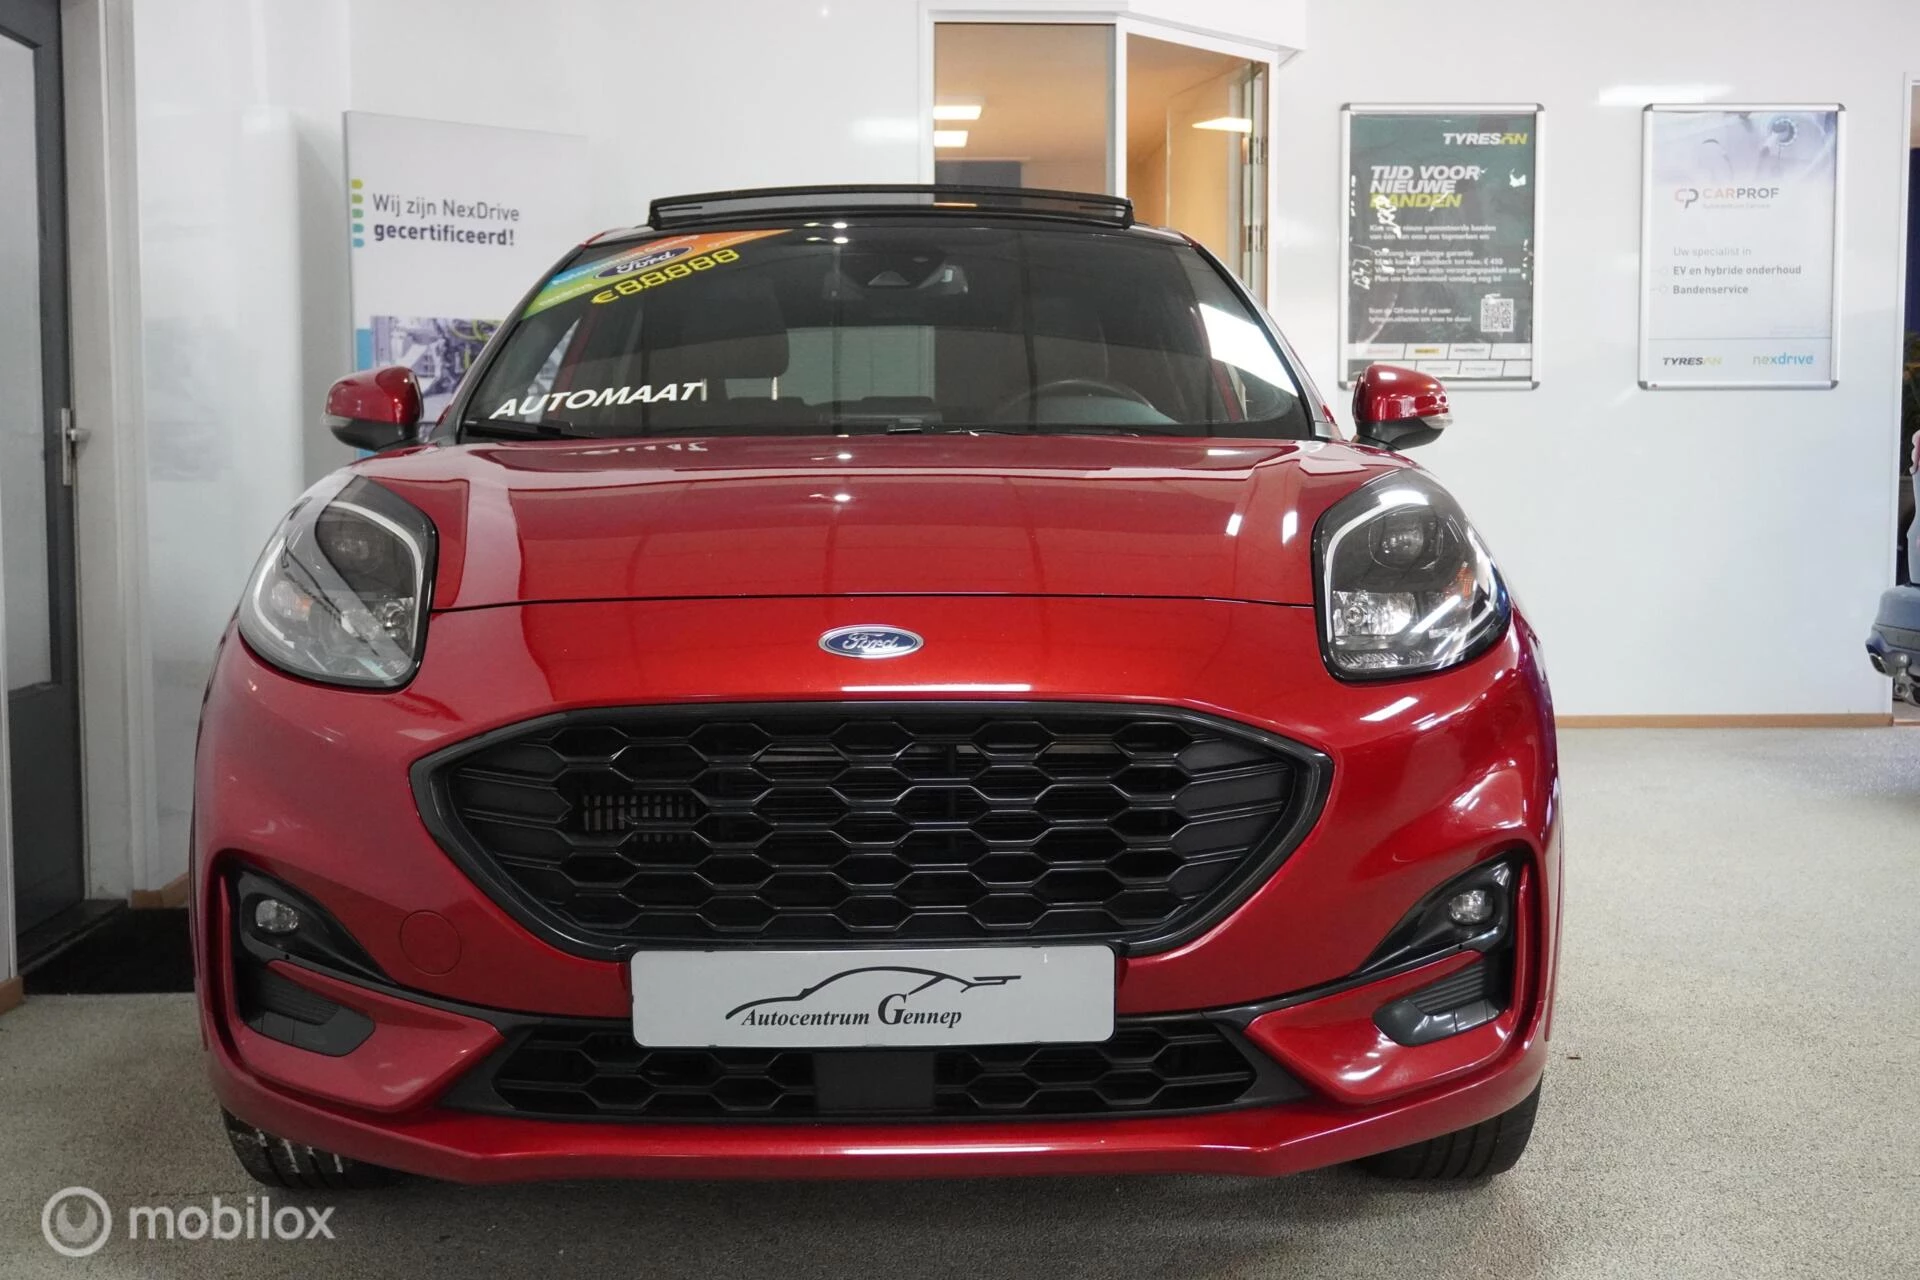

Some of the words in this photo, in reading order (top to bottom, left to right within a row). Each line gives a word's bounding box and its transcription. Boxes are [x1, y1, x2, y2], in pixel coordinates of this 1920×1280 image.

[1420, 165, 1480, 180] VOOR
[1370, 180, 1457, 193] NIEUWE
[1702, 187, 1780, 199] CARPROF
[372, 193, 400, 218] Wij
[406, 196, 437, 219] zijn
[443, 199, 520, 221] NexDrive
[374, 223, 514, 246] gecertificeerd!
[1692, 246, 1740, 258] specialist
[616, 250, 675, 273] Ford
[1673, 266, 1687, 275] EV
[1689, 267, 1702, 275] en
[1704, 265, 1743, 277] hybride
[1746, 265, 1802, 275] onderhoud
[1673, 284, 1749, 295] Bandenservice
[1752, 352, 1815, 365] nexdrive
[489, 382, 702, 420] AUTOMAAT
[842, 632, 900, 650] Ford
[741, 1008, 870, 1027] Autocentrum
[877, 993, 962, 1029] Gennep
